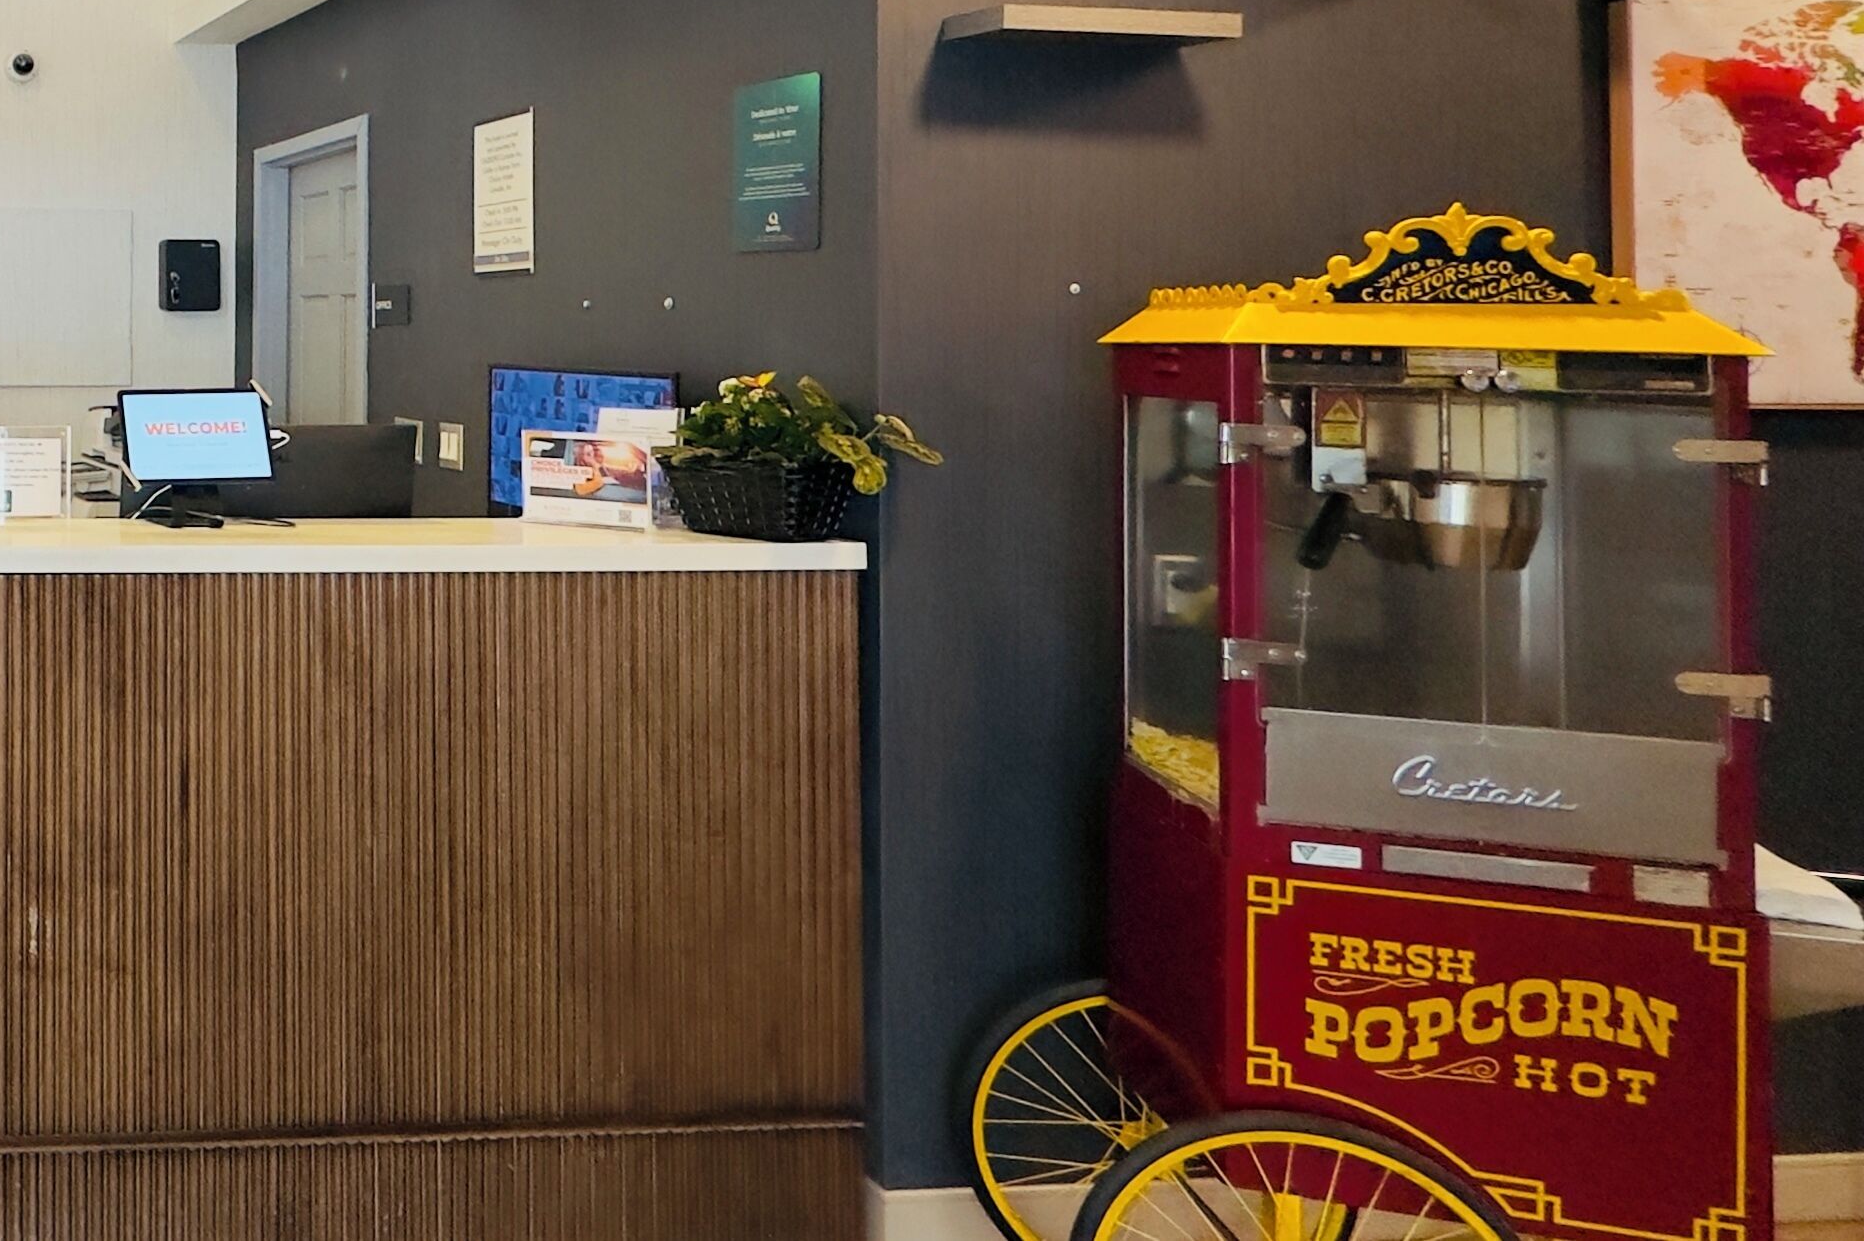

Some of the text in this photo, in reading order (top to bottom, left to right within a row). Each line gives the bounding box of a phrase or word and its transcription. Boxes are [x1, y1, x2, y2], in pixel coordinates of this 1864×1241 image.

[144, 421, 248, 436] WELCOME!
[1308, 931, 1477, 986] FRESH
[1304, 977, 1680, 1060] POPCORN
[1512, 1053, 1658, 1106] HOT
